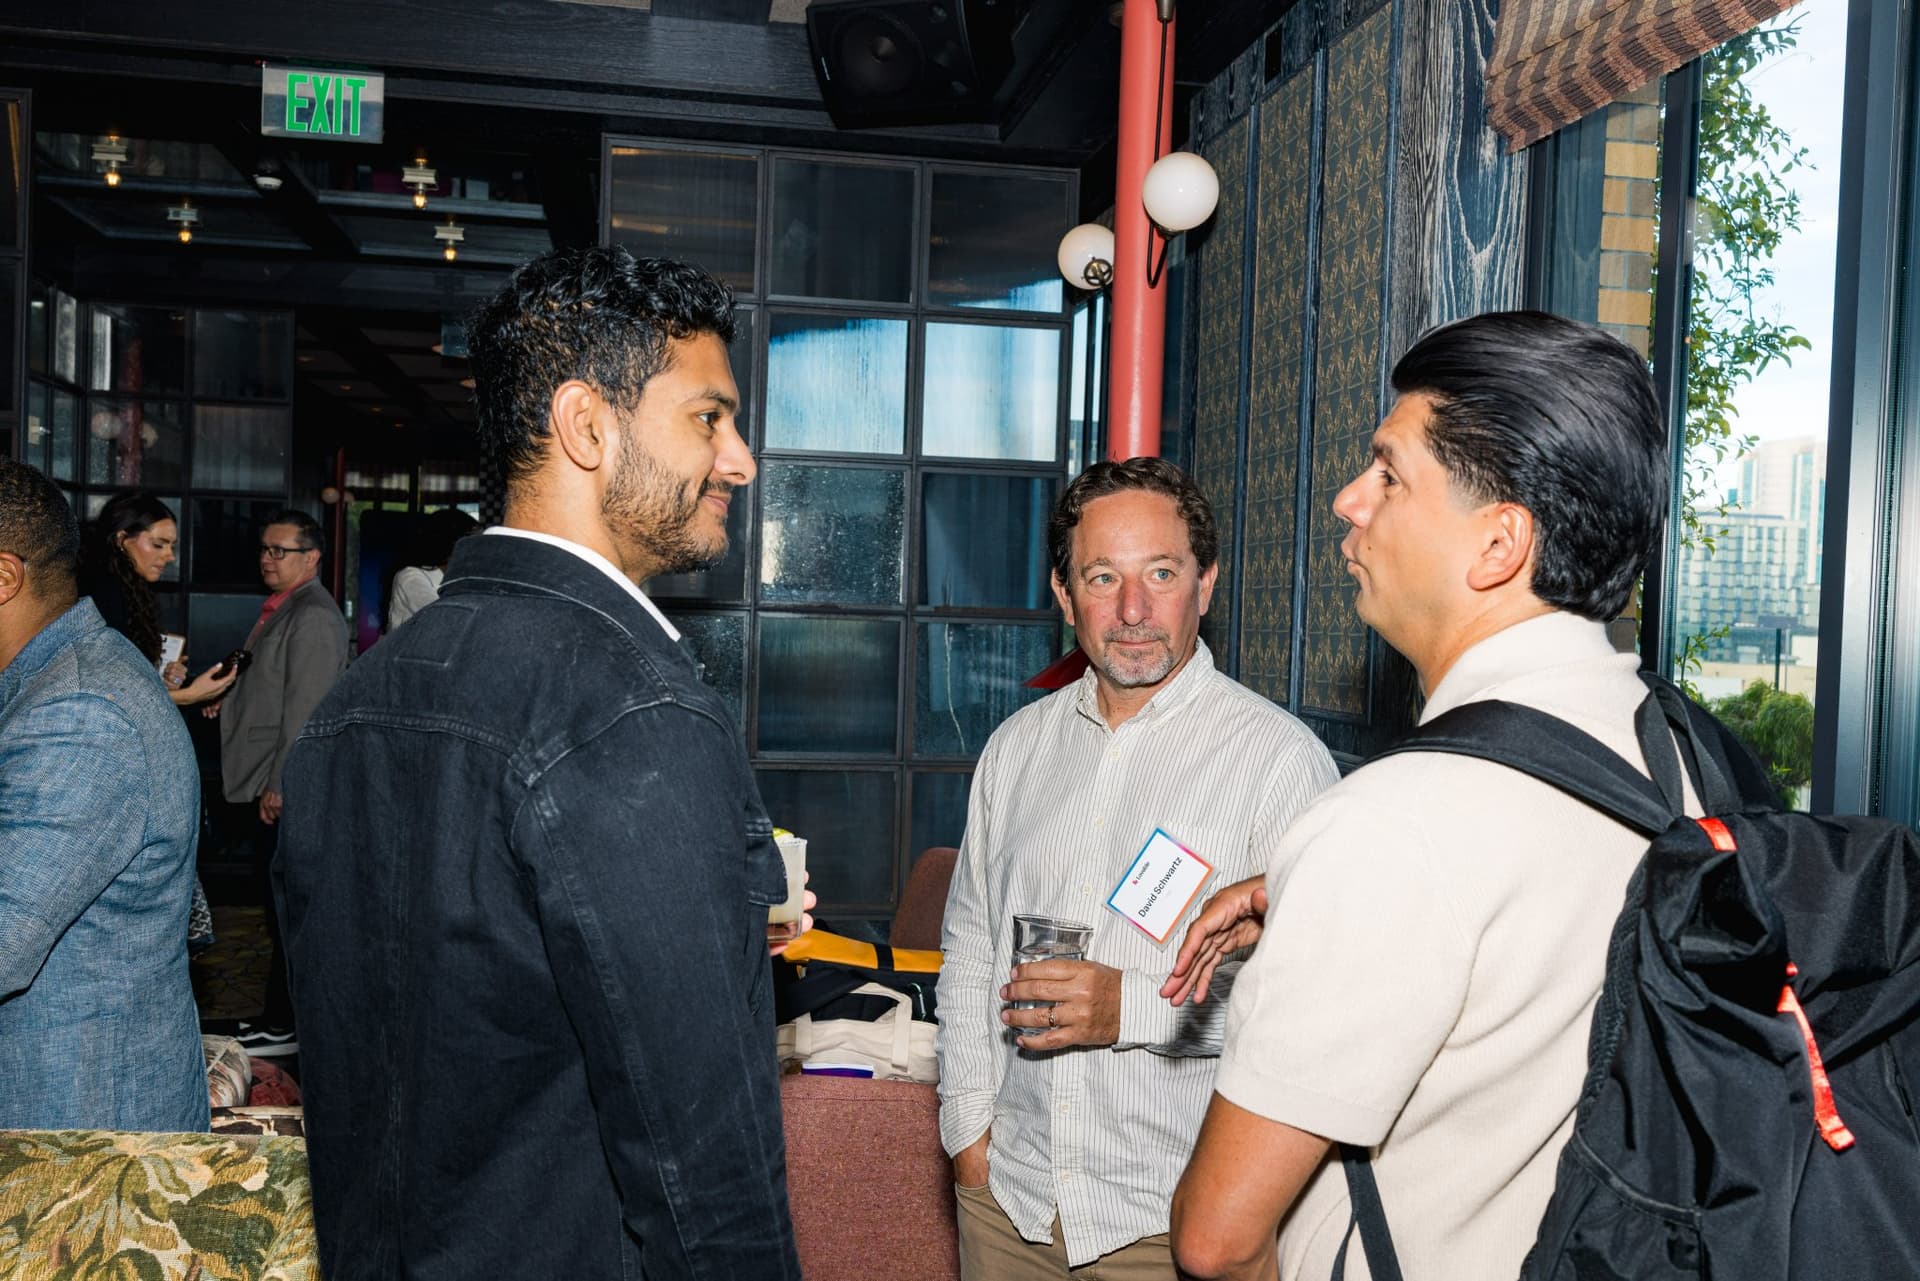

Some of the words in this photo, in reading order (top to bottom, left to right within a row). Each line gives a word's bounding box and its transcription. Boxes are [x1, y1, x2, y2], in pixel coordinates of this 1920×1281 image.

[286, 72, 367, 136] EXIT
[1138, 893, 1157, 917] David
[1153, 856, 1182, 894] Schwartz
